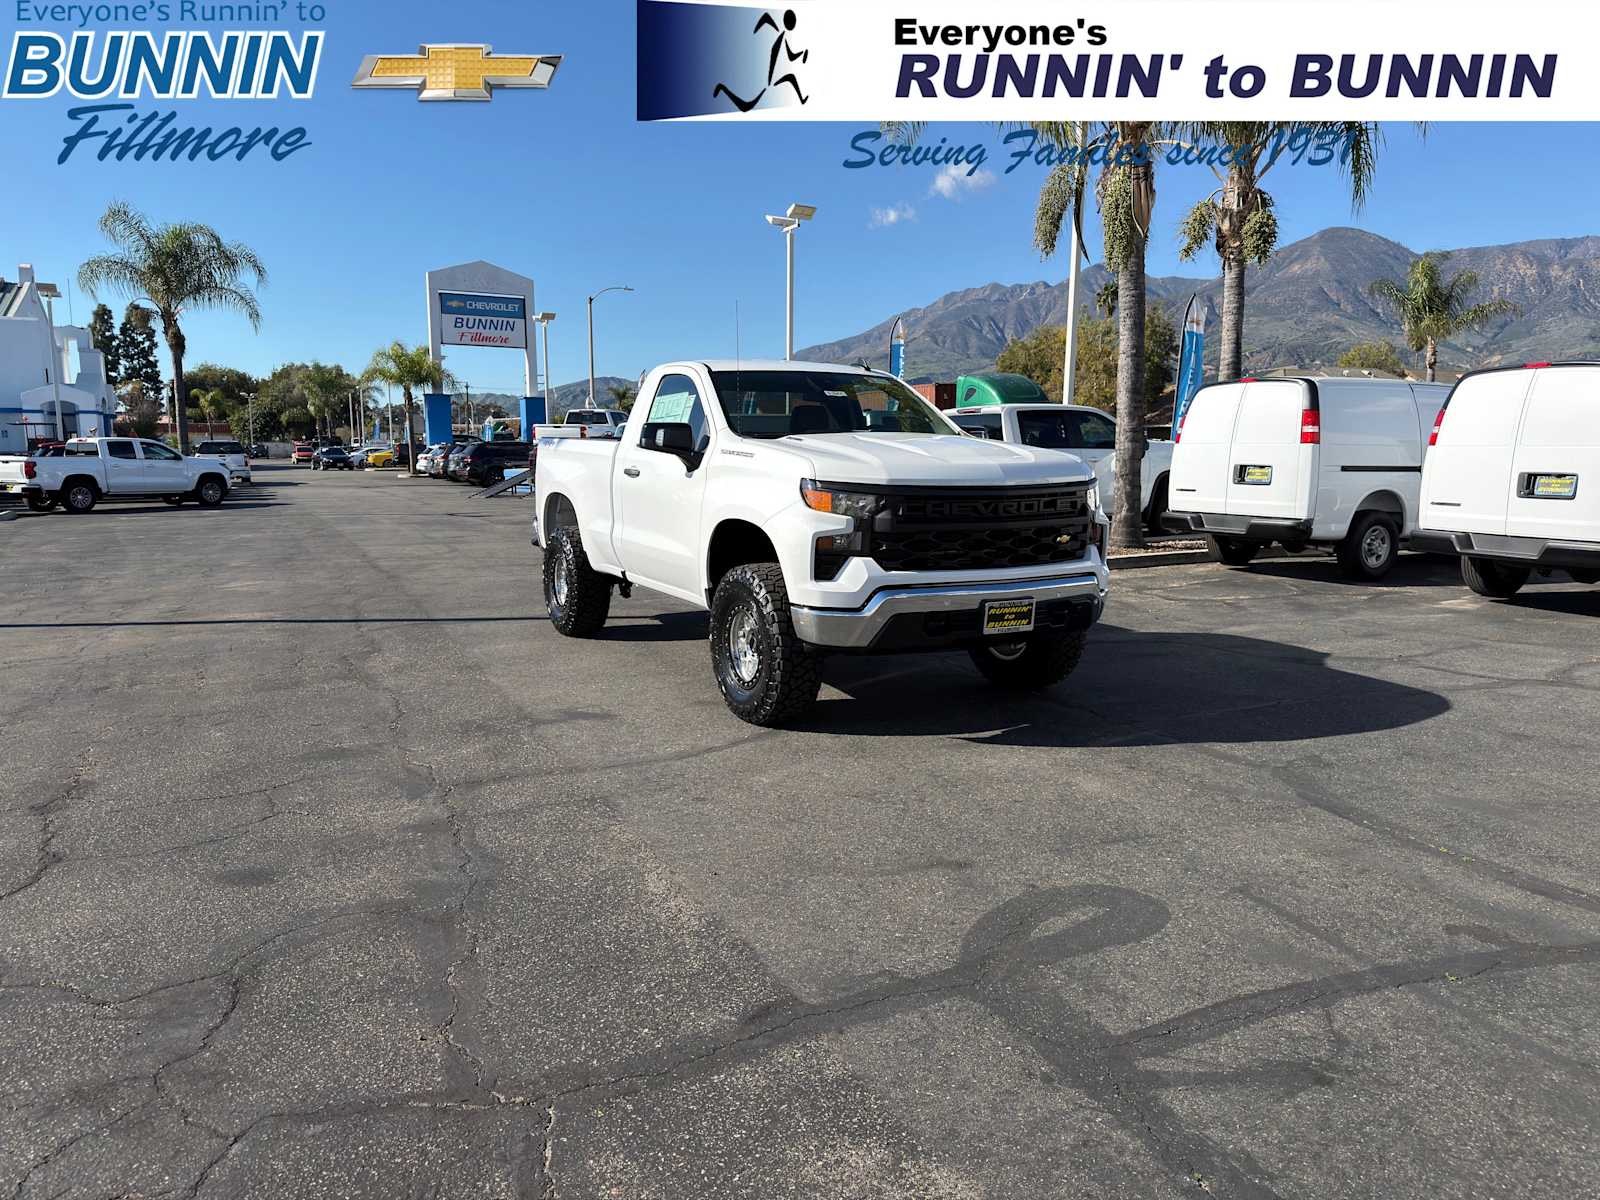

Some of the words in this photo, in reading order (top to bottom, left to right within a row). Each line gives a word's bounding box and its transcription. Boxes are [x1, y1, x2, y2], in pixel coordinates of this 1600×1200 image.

[466, 301, 519, 313] CHEVROLET
[454, 317, 515, 331] BUNNIN
[457, 331, 510, 344] Fillmore
[903, 496, 1086, 517] CHEVROLET
